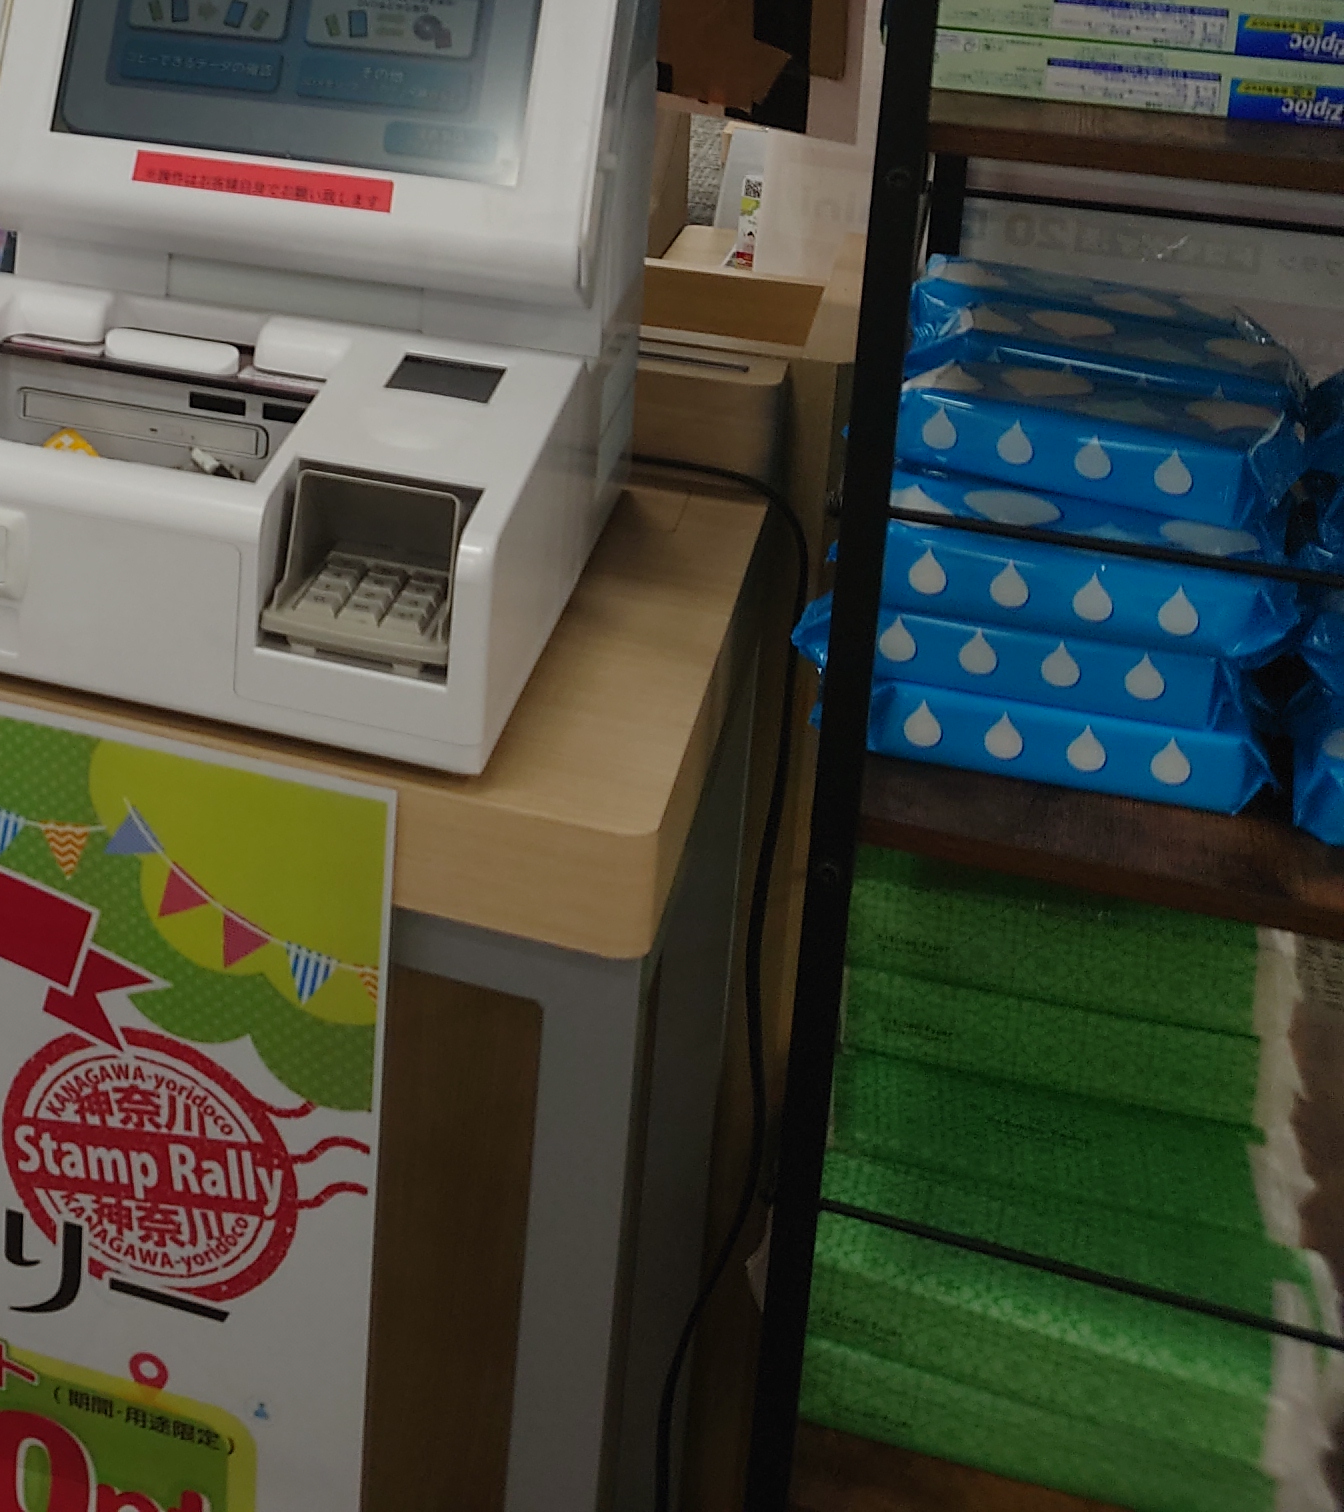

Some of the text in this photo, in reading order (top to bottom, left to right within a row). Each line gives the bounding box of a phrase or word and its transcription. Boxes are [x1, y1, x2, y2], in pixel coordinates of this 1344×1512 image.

[45, 1062, 235, 1138] KANAGAWA-yoridoco
[75, 1085, 207, 1138] 神奈川
[14, 1125, 283, 1218] Stamp Rally
[79, 1197, 229, 1250] 神奈川
[53, 1386, 235, 1455] (期間・用途限定)
